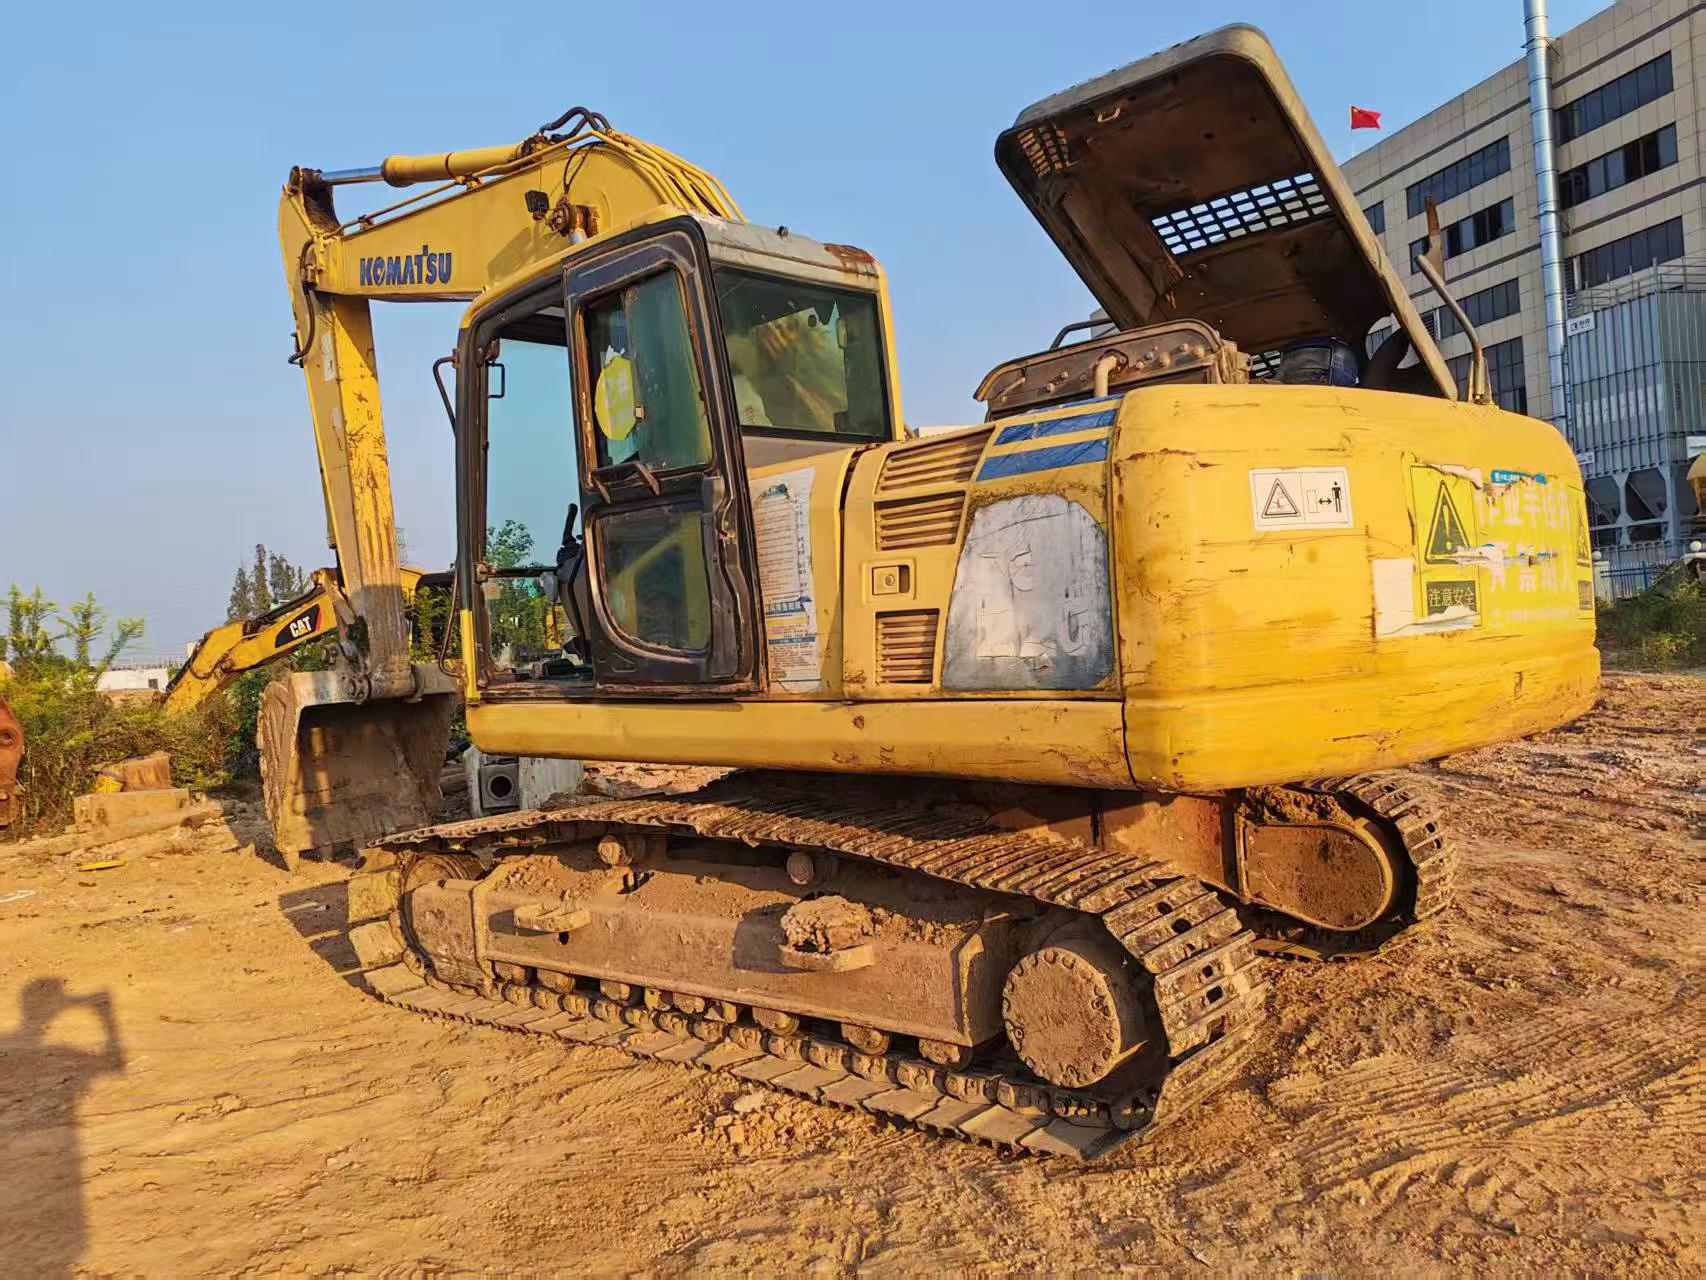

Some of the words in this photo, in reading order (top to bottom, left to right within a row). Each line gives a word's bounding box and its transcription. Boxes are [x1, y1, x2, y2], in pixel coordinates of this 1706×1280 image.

[360, 245, 452, 285] KOMATSU
[1428, 586, 1475, 607] 注意安全
[290, 616, 312, 638] CAT
